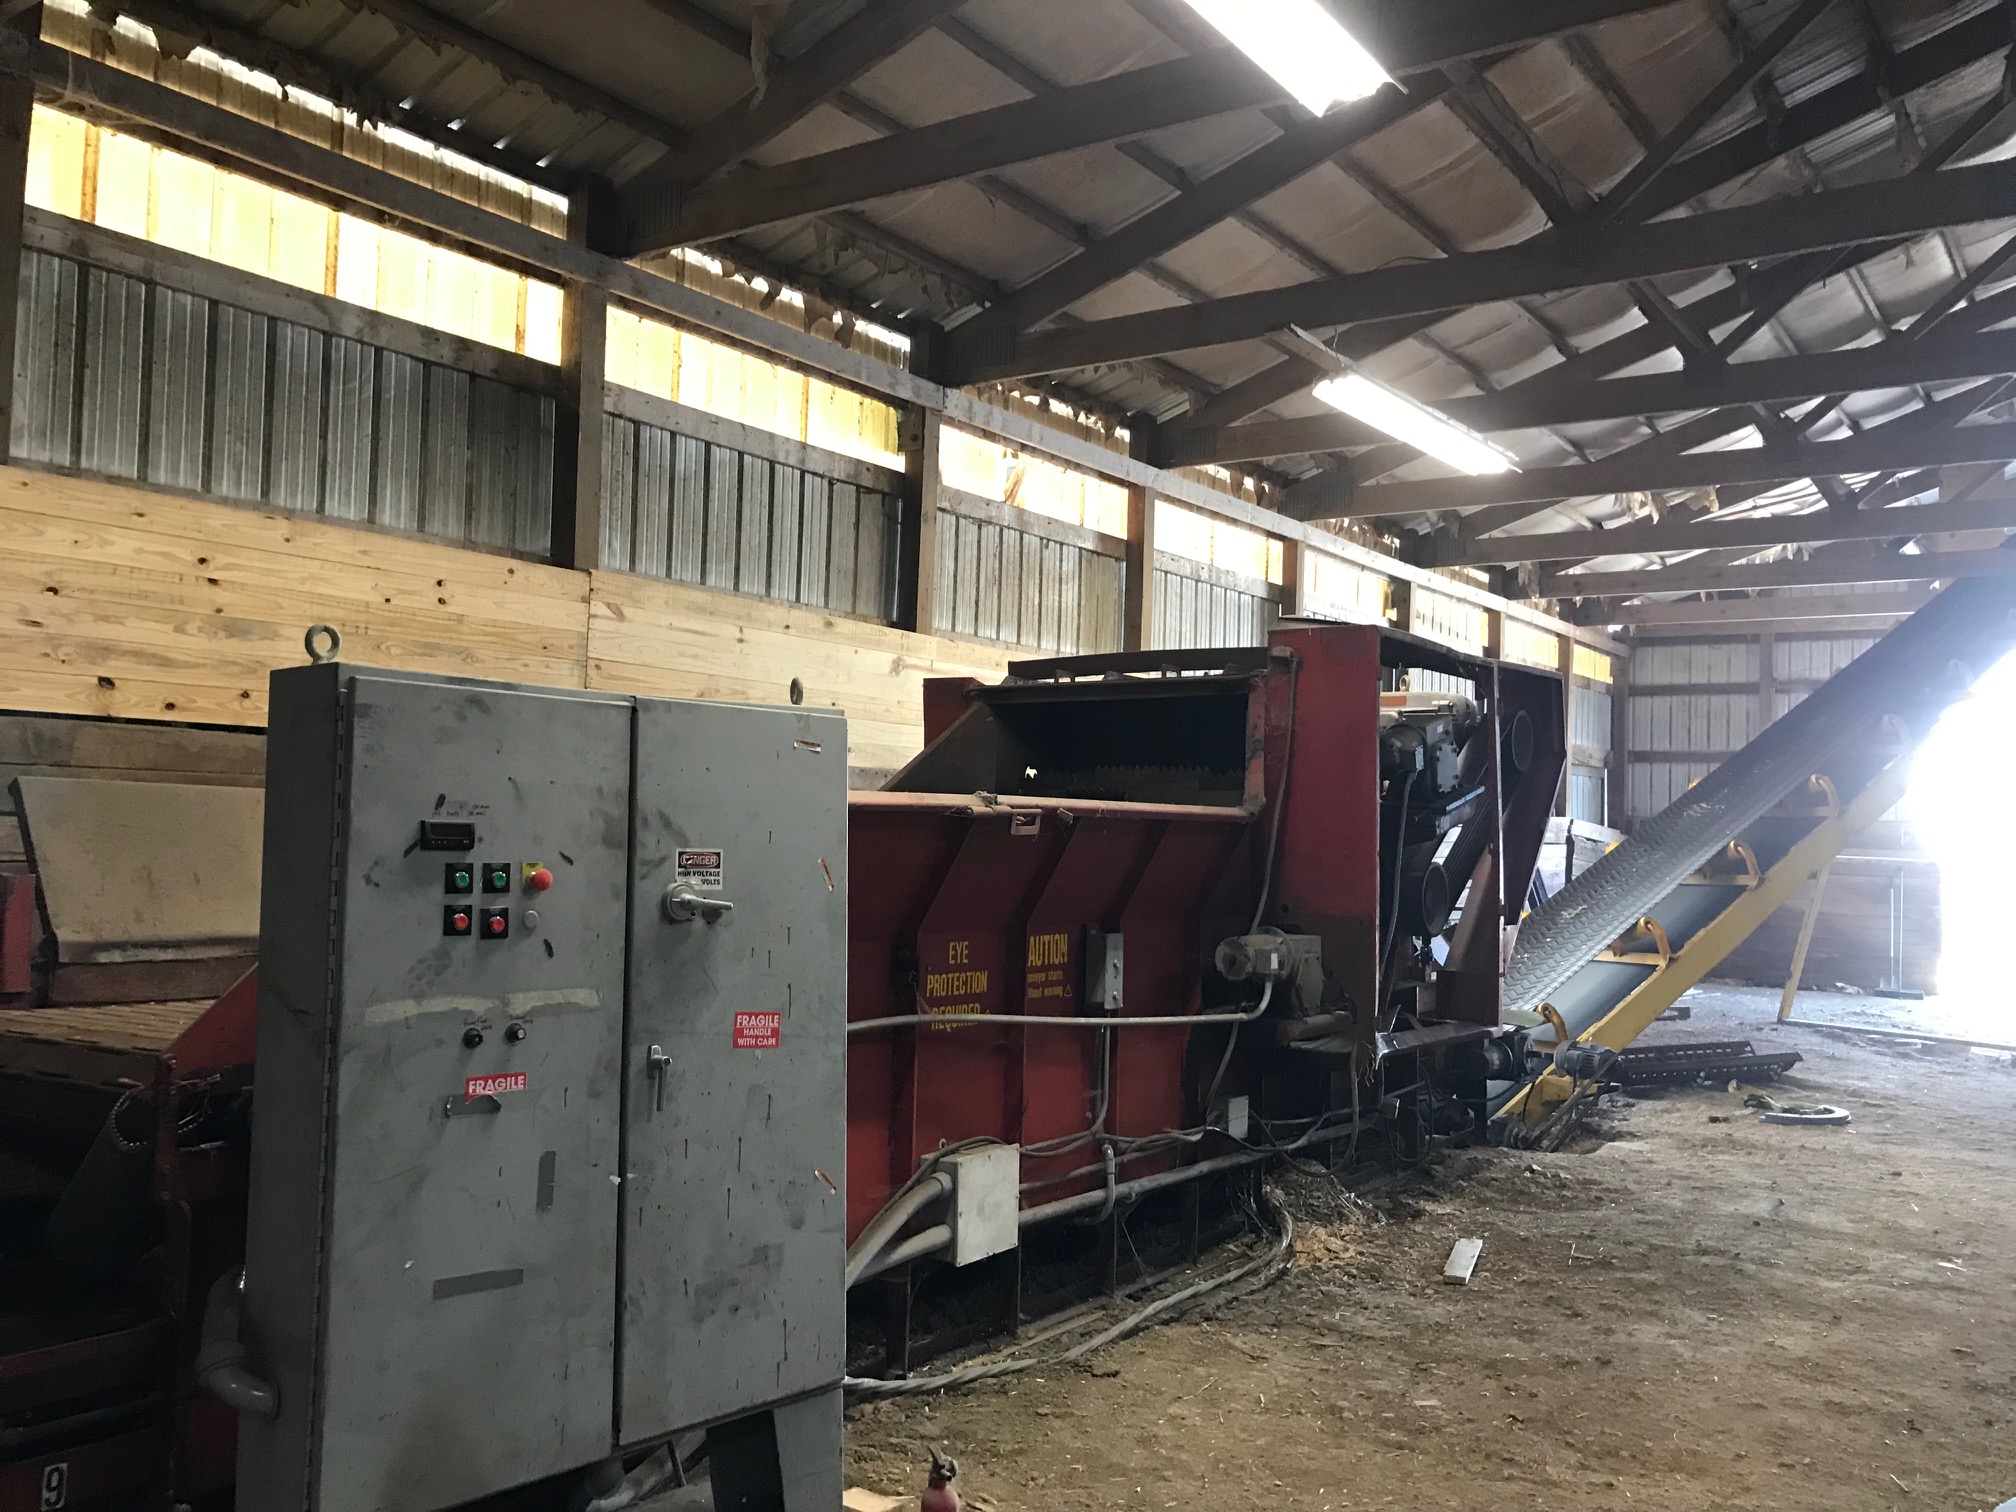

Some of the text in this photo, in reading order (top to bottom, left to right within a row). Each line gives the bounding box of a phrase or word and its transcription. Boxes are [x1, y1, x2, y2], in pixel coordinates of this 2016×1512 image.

[949, 941, 969, 964] EYE
[926, 970, 988, 998] PROTECTION
[737, 1014, 779, 1027] FRAGILE
[743, 1027, 772, 1036] HANDLE
[737, 1037, 776, 1046] WITH CARE
[468, 1075, 525, 1094] FRAGILE
[44, 1466, 65, 1507] 9
